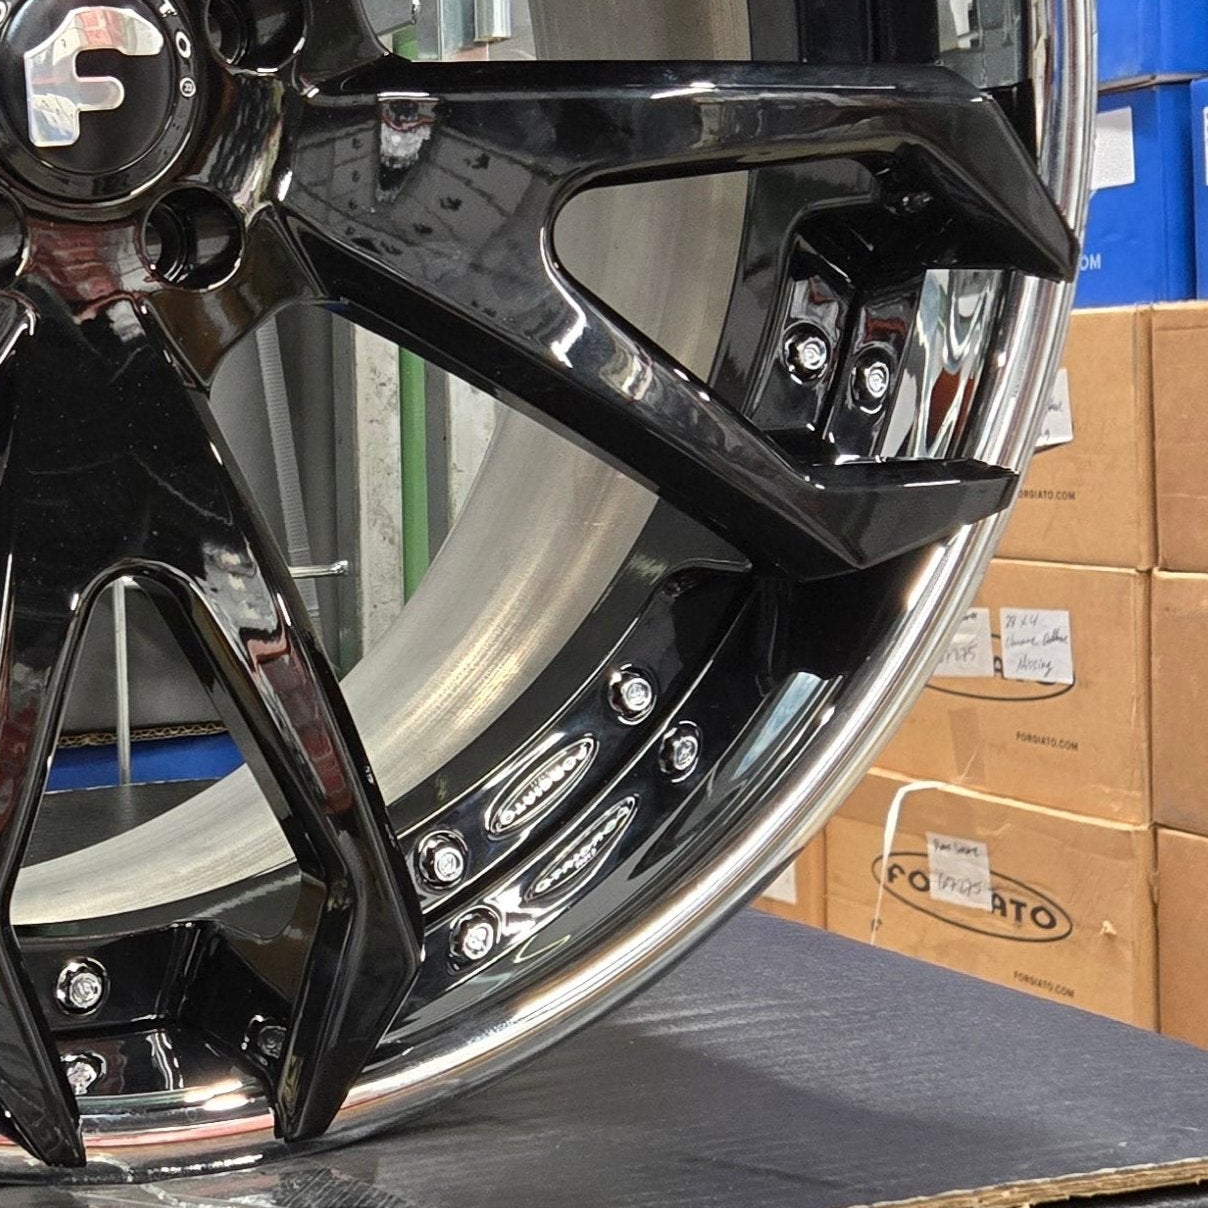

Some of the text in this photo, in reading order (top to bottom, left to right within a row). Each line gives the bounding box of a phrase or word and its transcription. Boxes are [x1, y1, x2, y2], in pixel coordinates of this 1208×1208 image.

[1016, 731, 1079, 751] FORGIATO.COM
[887, 863, 1056, 930] FOATO
[1014, 970, 1075, 998] FORGIATO.COM
